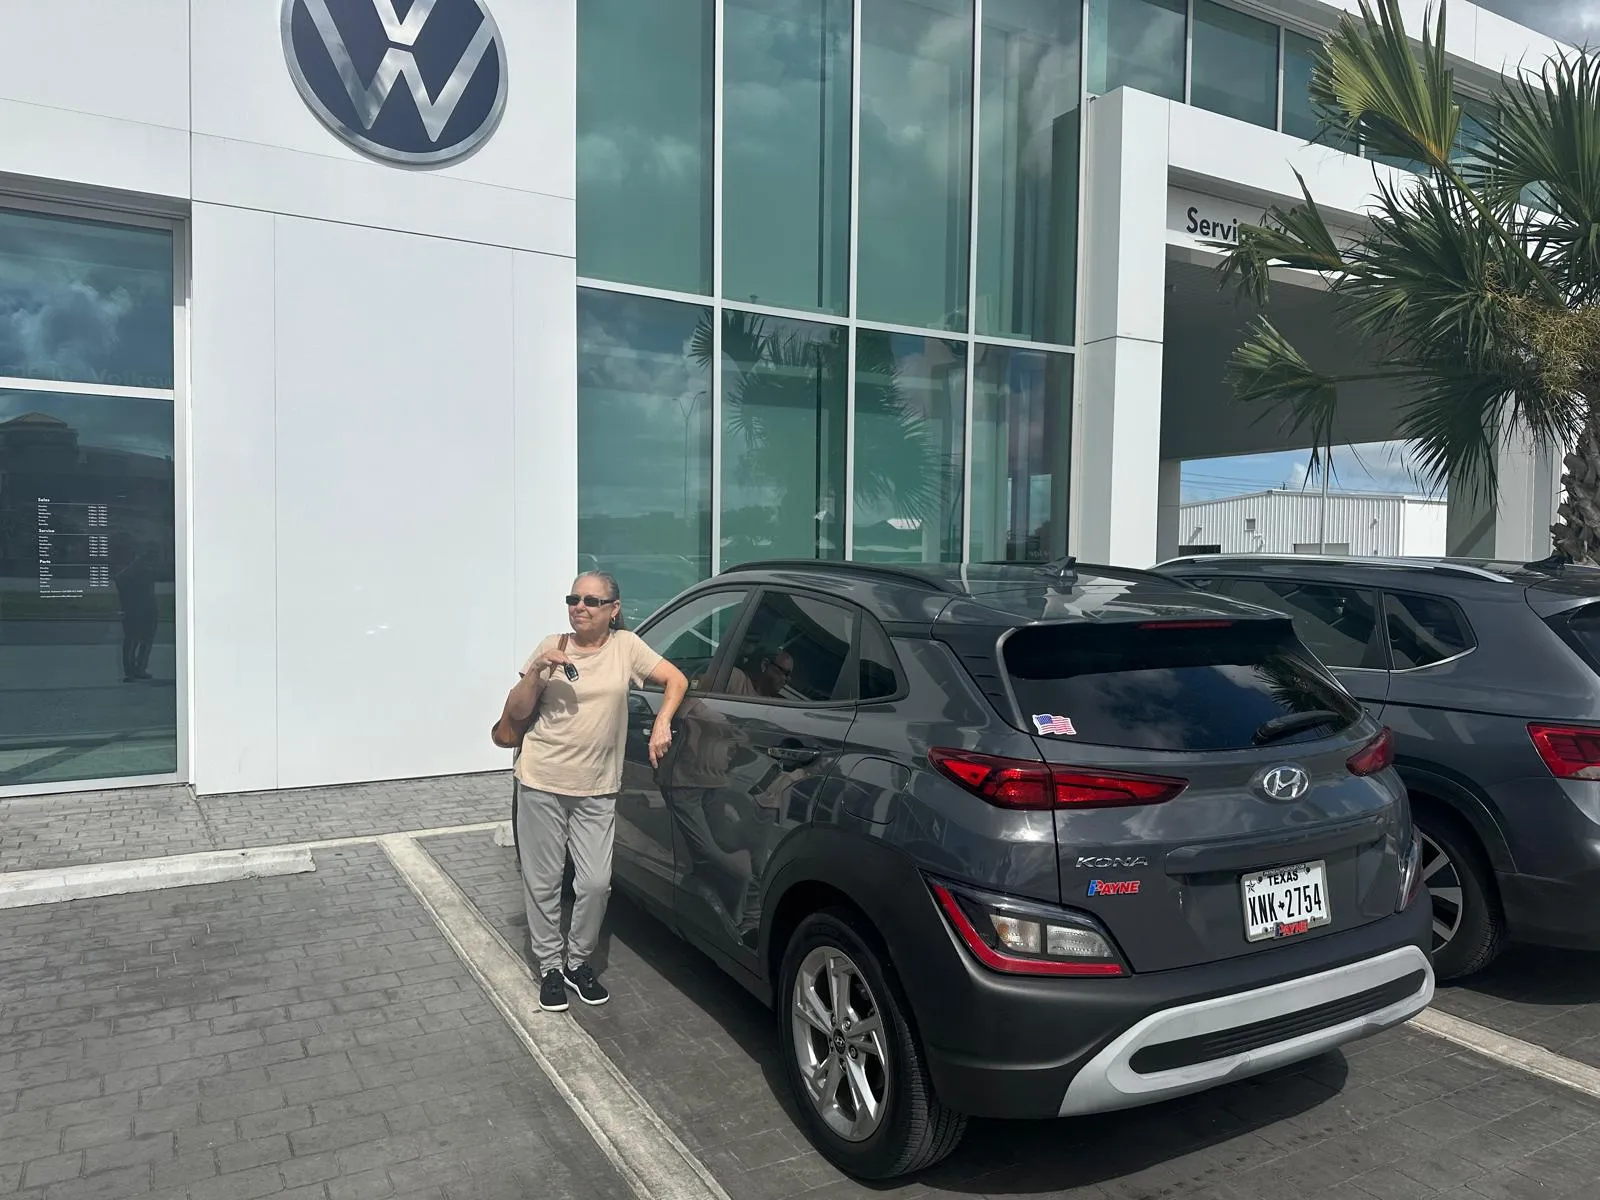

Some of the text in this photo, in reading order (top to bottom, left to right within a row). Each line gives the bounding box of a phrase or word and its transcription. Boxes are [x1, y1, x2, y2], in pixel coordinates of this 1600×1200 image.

[1186, 206, 1251, 245] Servi
[1075, 856, 1149, 868] KONA
[1267, 870, 1299, 886] TEXAS
[1087, 880, 1141, 896] PAYNE
